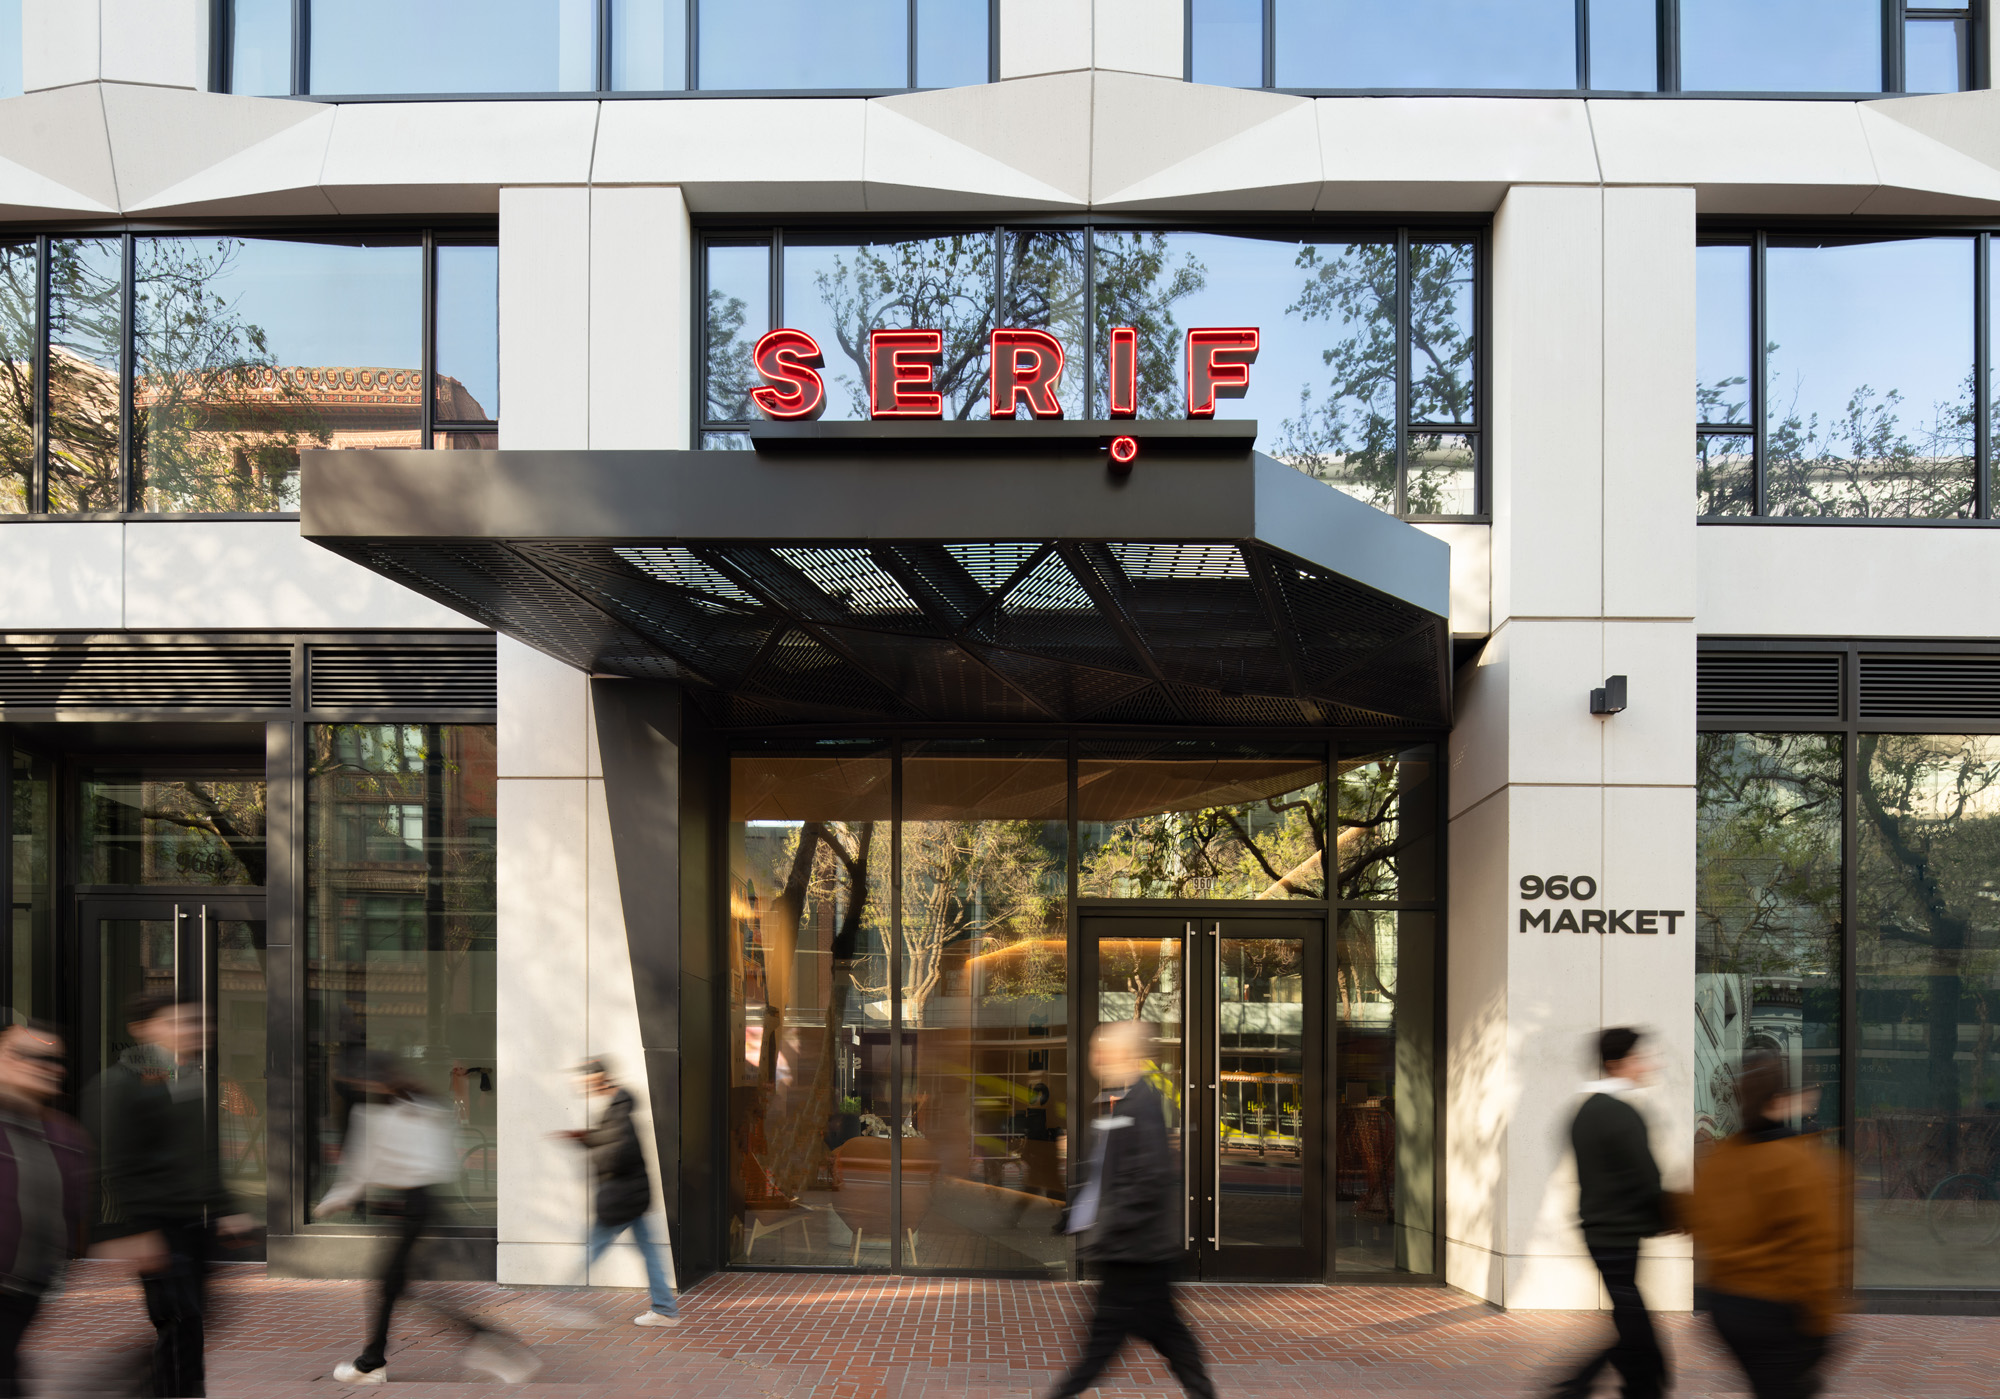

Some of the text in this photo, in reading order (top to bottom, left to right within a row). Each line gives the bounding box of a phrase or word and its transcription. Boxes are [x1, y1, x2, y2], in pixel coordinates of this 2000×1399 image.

[749, 327, 1260, 421] SERIF
[1193, 878, 1212, 889] 960
[1519, 875, 1597, 901] 960
[1519, 909, 1685, 935] MARKET
